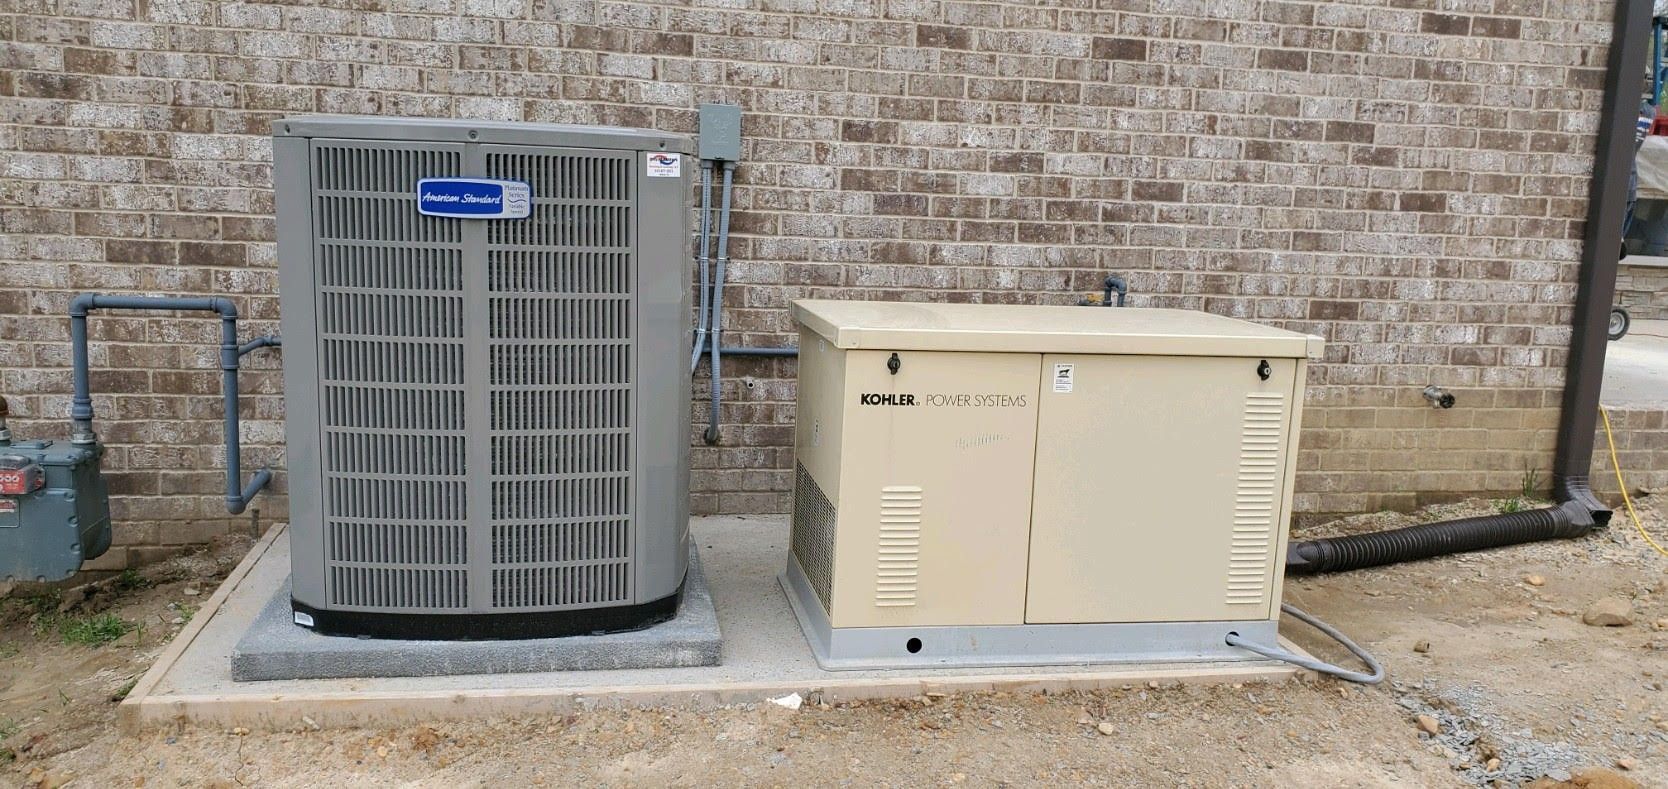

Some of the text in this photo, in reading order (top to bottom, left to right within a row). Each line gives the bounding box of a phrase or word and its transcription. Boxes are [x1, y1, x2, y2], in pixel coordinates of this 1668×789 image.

[421, 191, 502, 204] American Standard
[860, 393, 1027, 408] KOHLER POWER SYSTEMS
